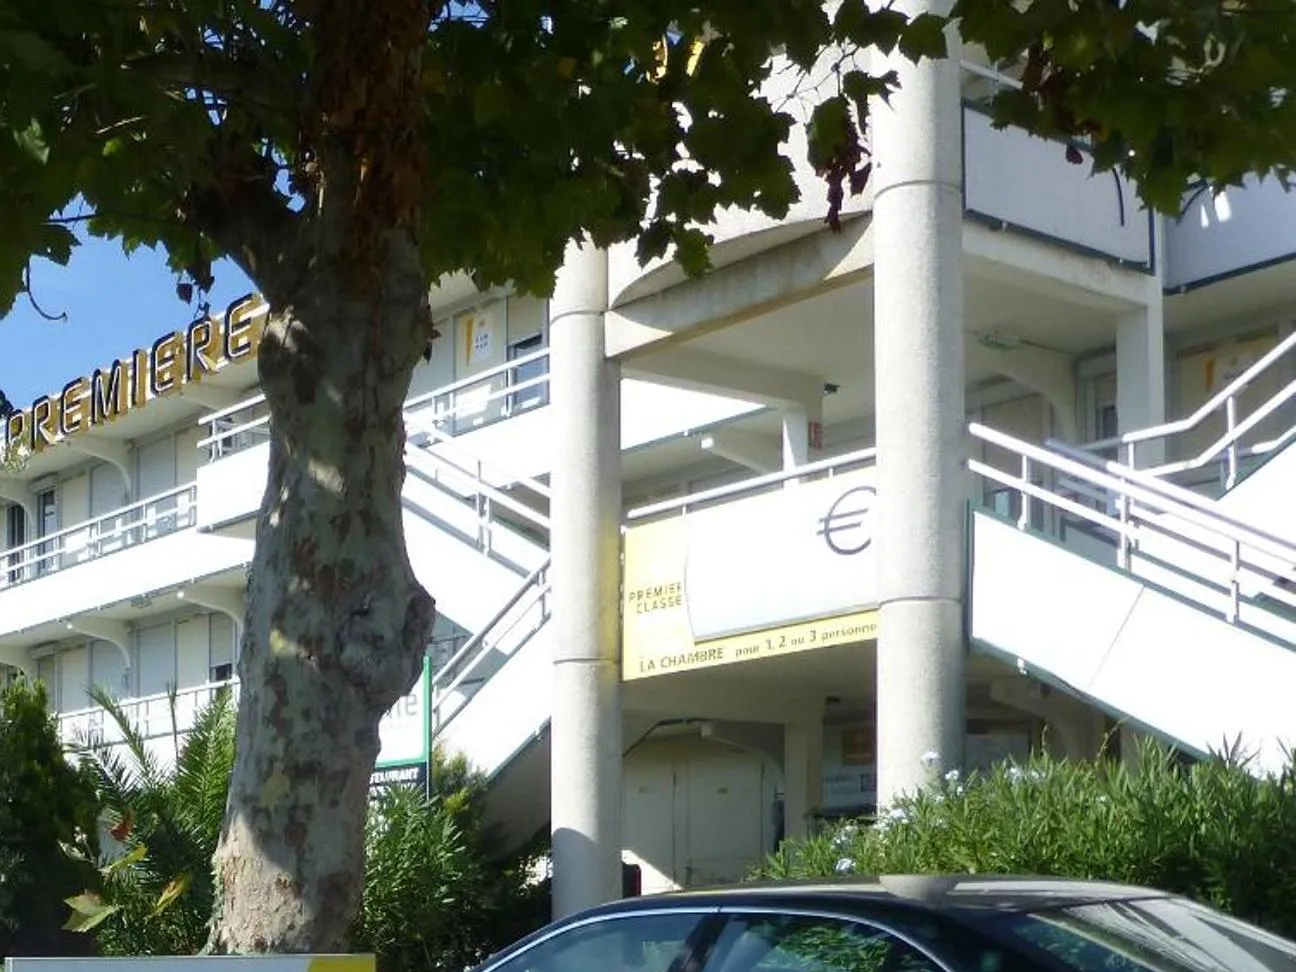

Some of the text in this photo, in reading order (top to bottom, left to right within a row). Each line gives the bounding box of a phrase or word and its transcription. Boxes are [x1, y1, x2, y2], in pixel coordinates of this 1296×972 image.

[636, 594, 682, 614] CLASSE
[640, 657, 656, 673] LA
[660, 647, 724, 669] CHAMBRE
[735, 642, 760, 657] pour
[778, 634, 787, 649] 2
[808, 629, 817, 643] 3
